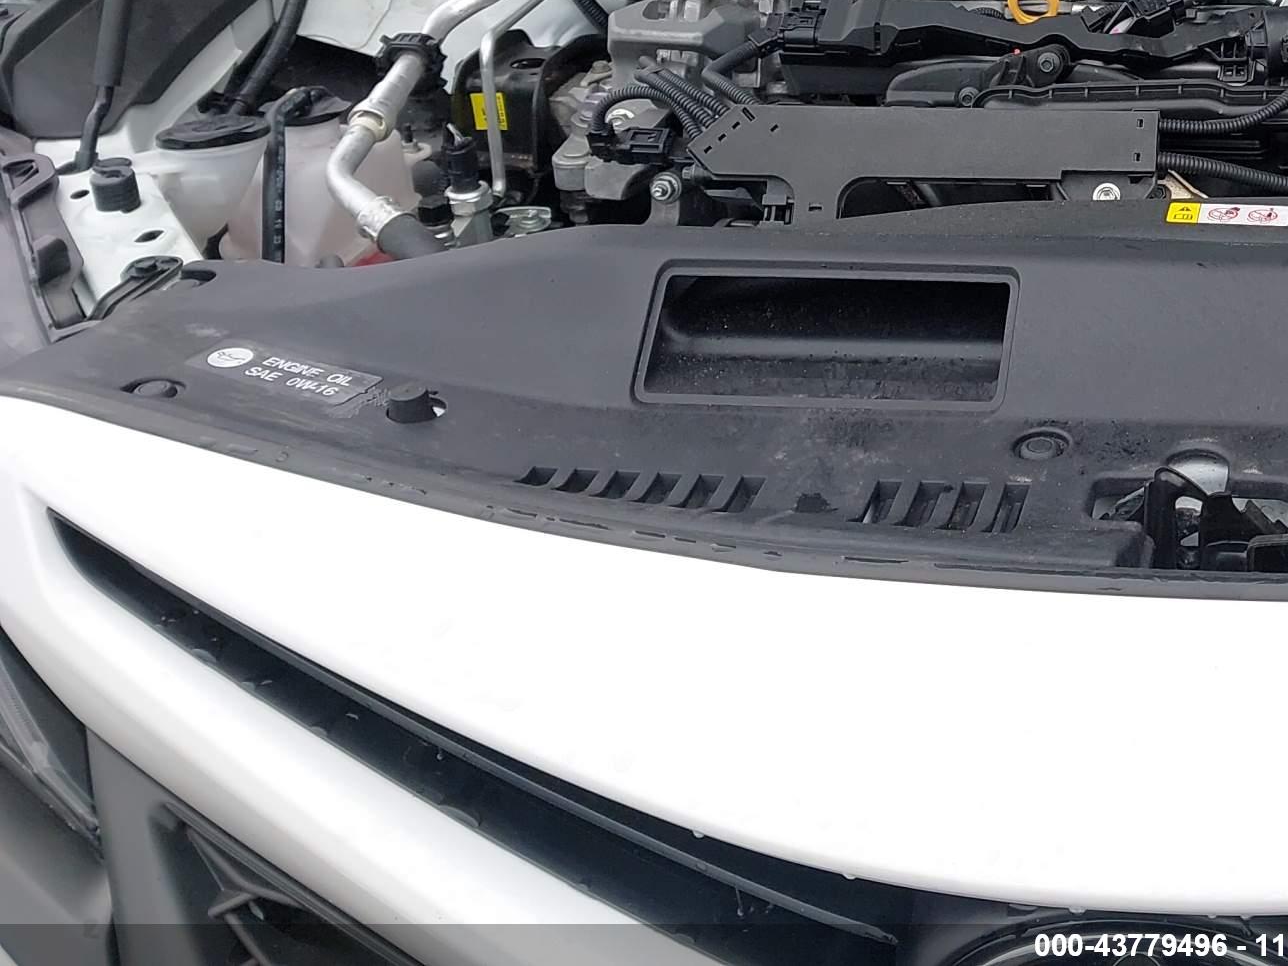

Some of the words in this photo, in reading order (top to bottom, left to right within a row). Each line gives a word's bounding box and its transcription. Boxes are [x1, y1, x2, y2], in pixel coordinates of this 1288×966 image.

[244, 366, 283, 382] SAE
[286, 378, 339, 396] 0W-16
[263, 357, 324, 377] ENGINE
[326, 373, 353, 386] OIL
